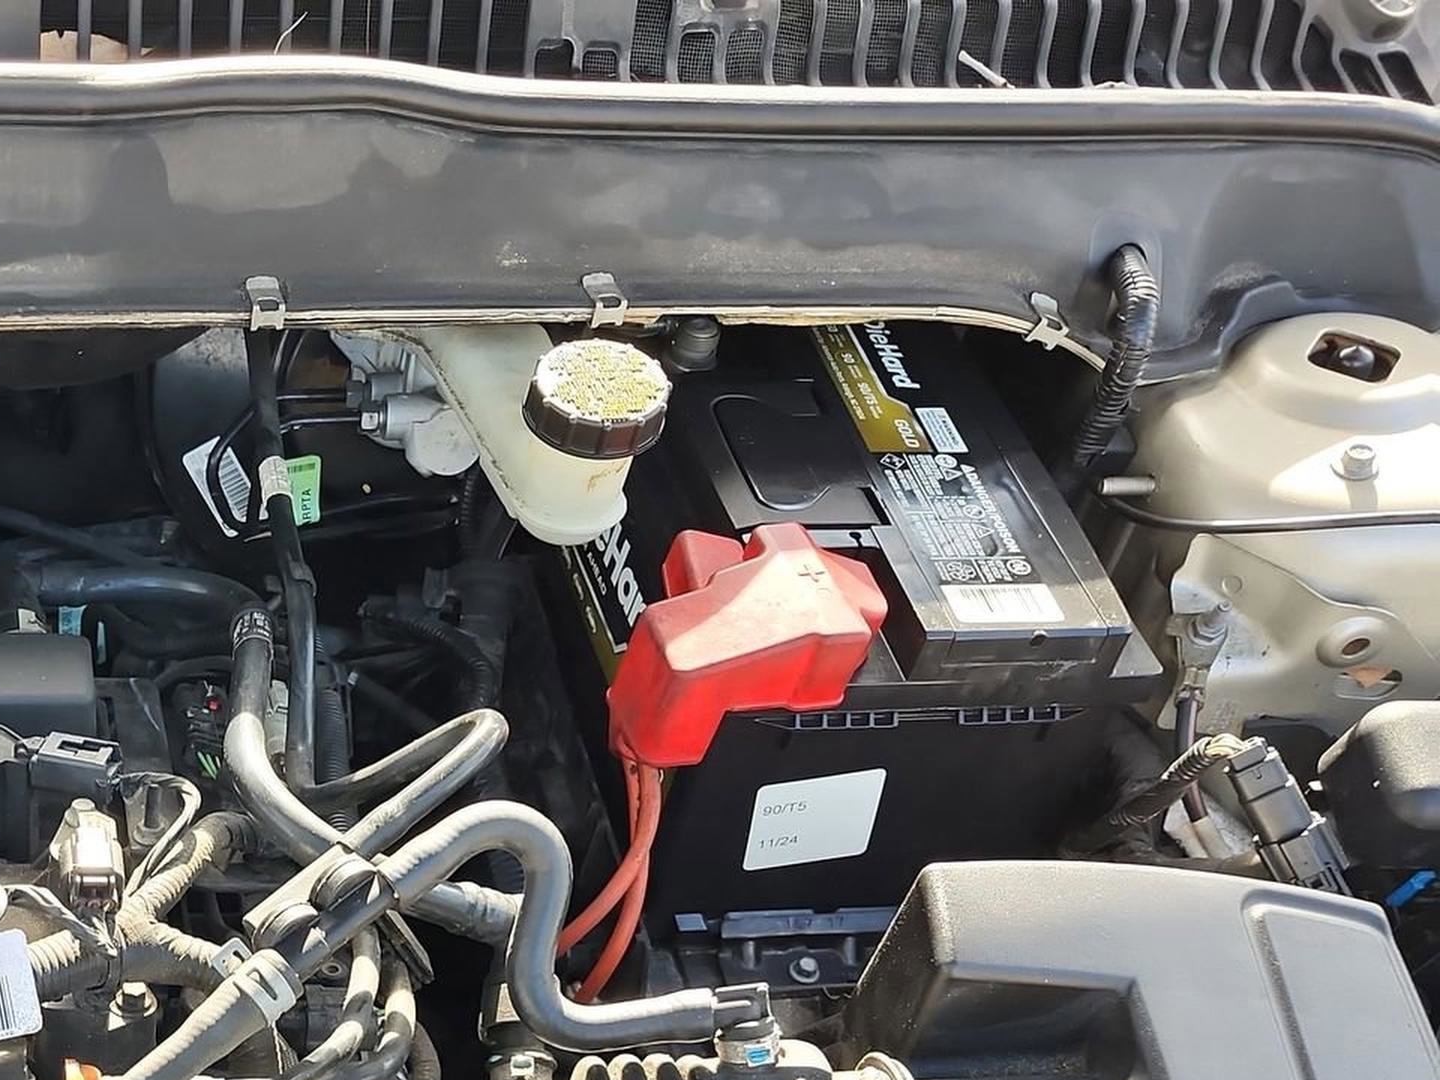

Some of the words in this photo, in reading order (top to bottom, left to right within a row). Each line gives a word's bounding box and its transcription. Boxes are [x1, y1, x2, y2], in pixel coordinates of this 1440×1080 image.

[863, 320, 921, 389] DieHard
[894, 419, 921, 449] GOLD
[301, 488, 312, 525] RPTA
[762, 800, 808, 818] 90/T5
[759, 834, 799, 849] 11/24
